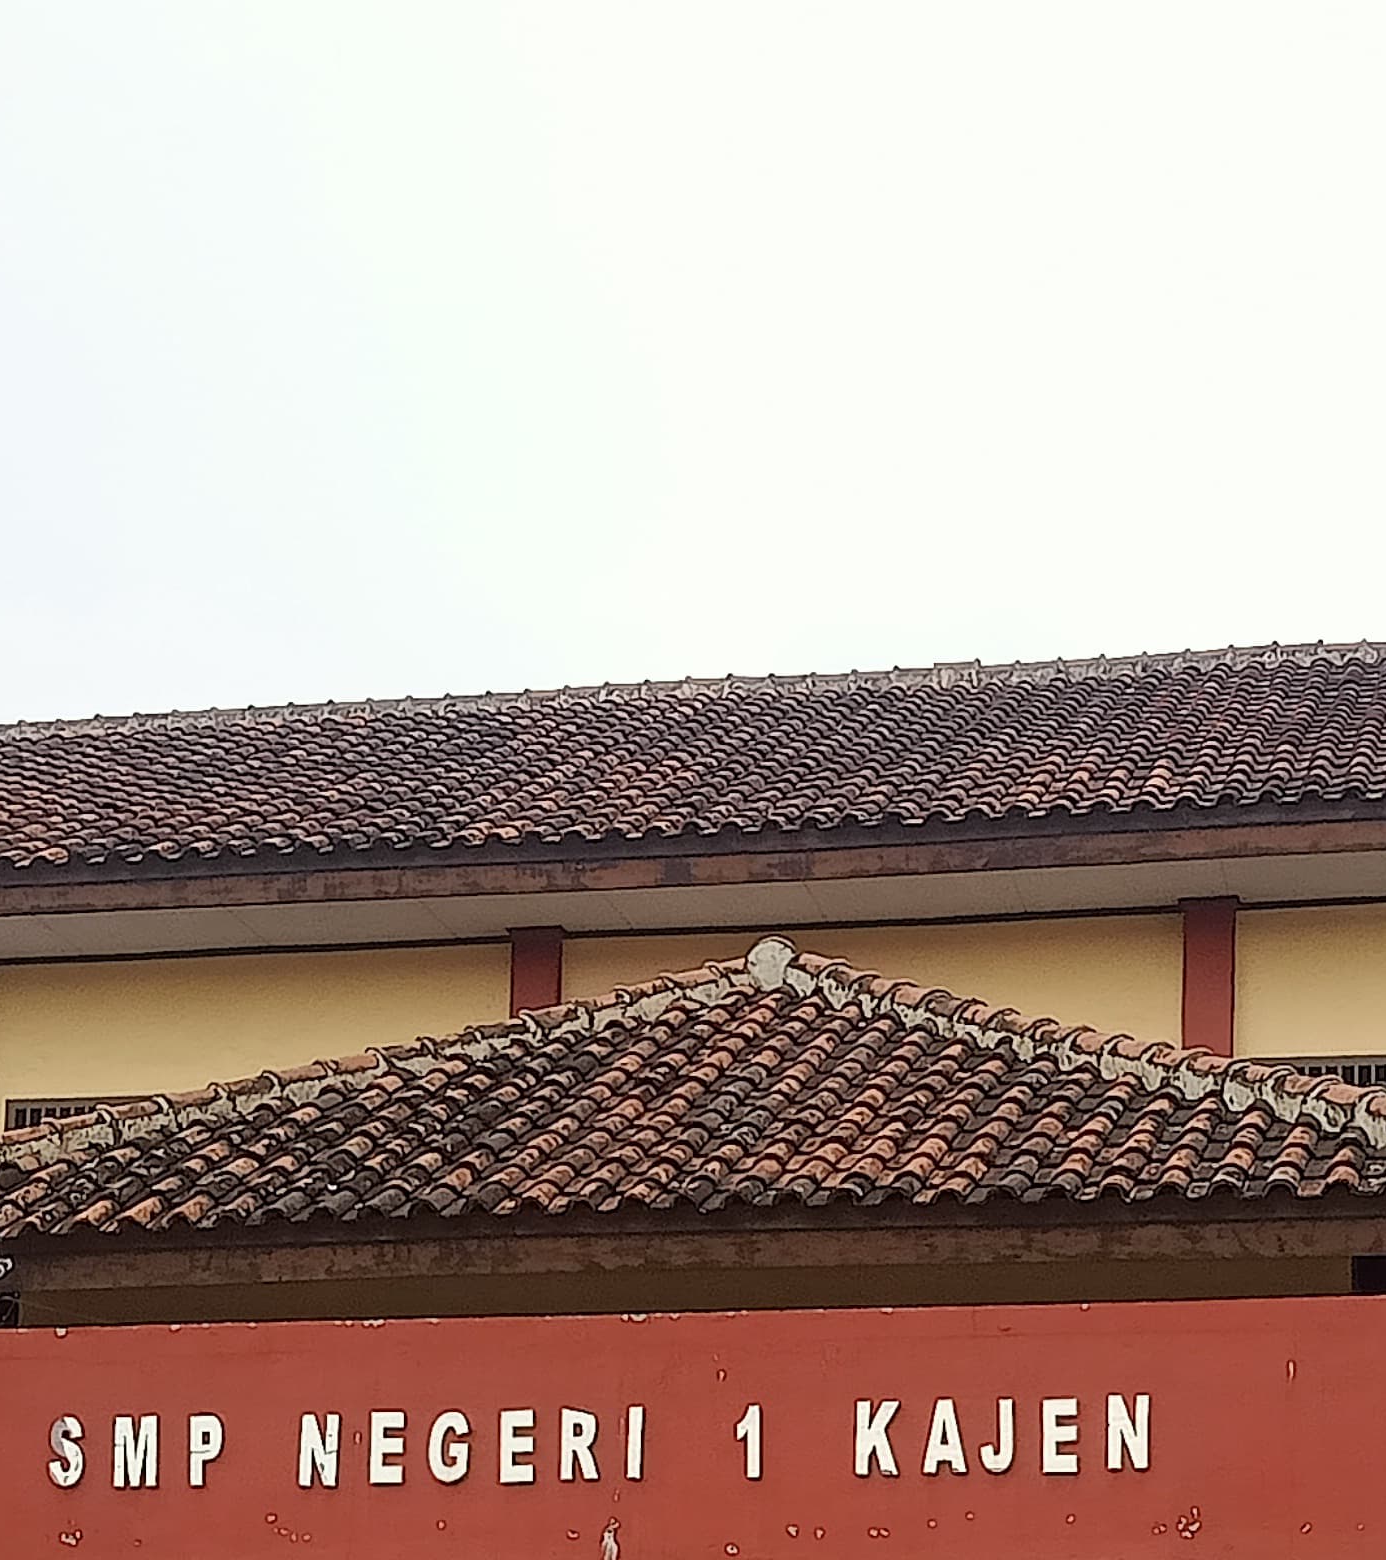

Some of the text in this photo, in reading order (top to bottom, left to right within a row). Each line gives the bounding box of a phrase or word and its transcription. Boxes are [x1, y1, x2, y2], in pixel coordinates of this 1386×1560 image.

[49, 1393, 1151, 1488] SMP NEGERI 1 KAJEN
